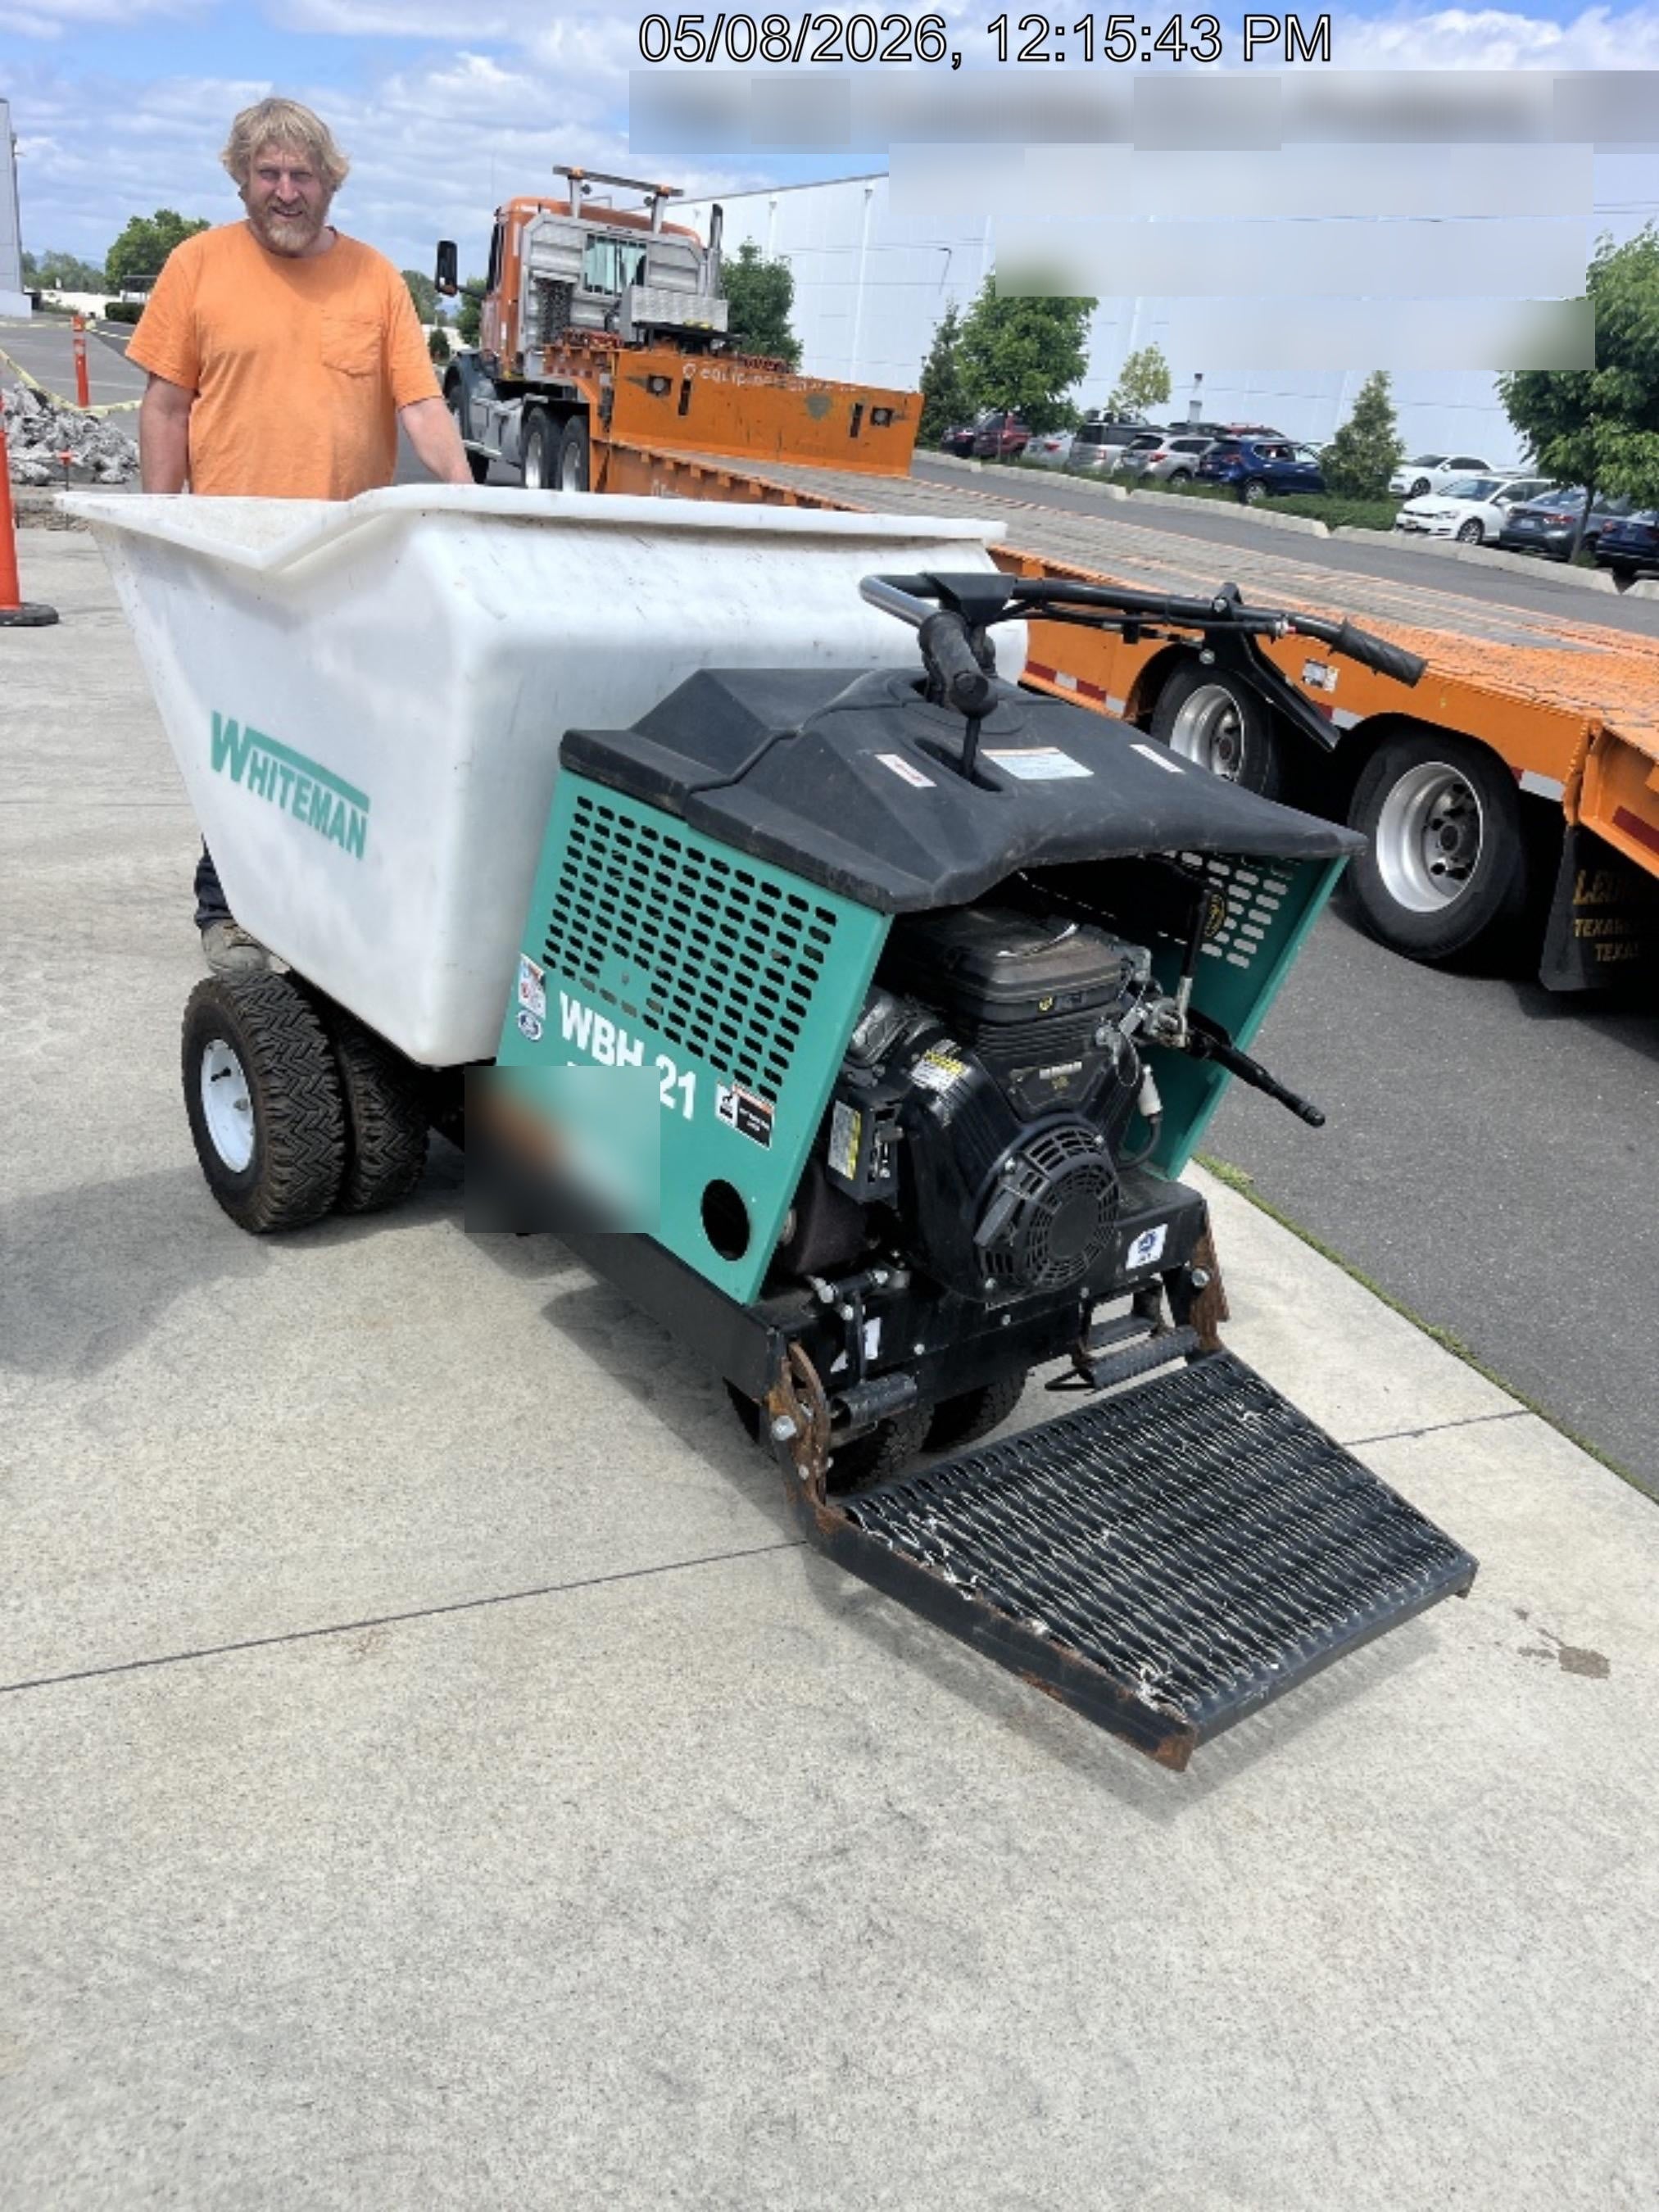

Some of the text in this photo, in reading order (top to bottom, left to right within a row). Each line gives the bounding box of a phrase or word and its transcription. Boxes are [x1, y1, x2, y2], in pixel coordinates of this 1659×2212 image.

[211, 709, 370, 860] WHITEMAN
[560, 990, 644, 1067] WBH
[655, 1054, 696, 1121] 21
